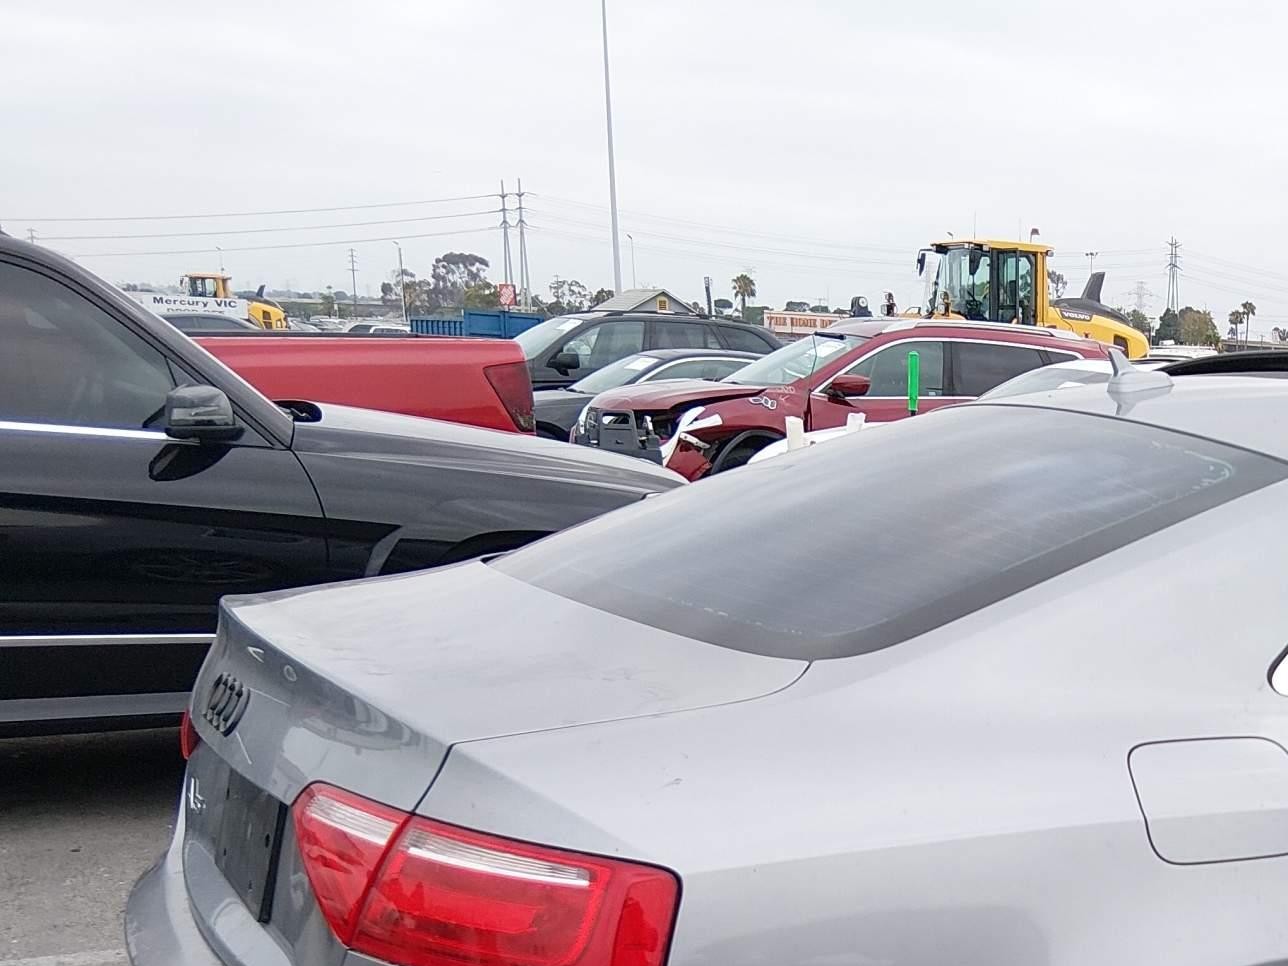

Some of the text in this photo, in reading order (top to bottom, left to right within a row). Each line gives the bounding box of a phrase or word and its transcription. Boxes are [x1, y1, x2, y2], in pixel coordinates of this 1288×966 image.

[153, 296, 238, 309] Mercury VIC
[1062, 311, 1091, 321] VOLVO
